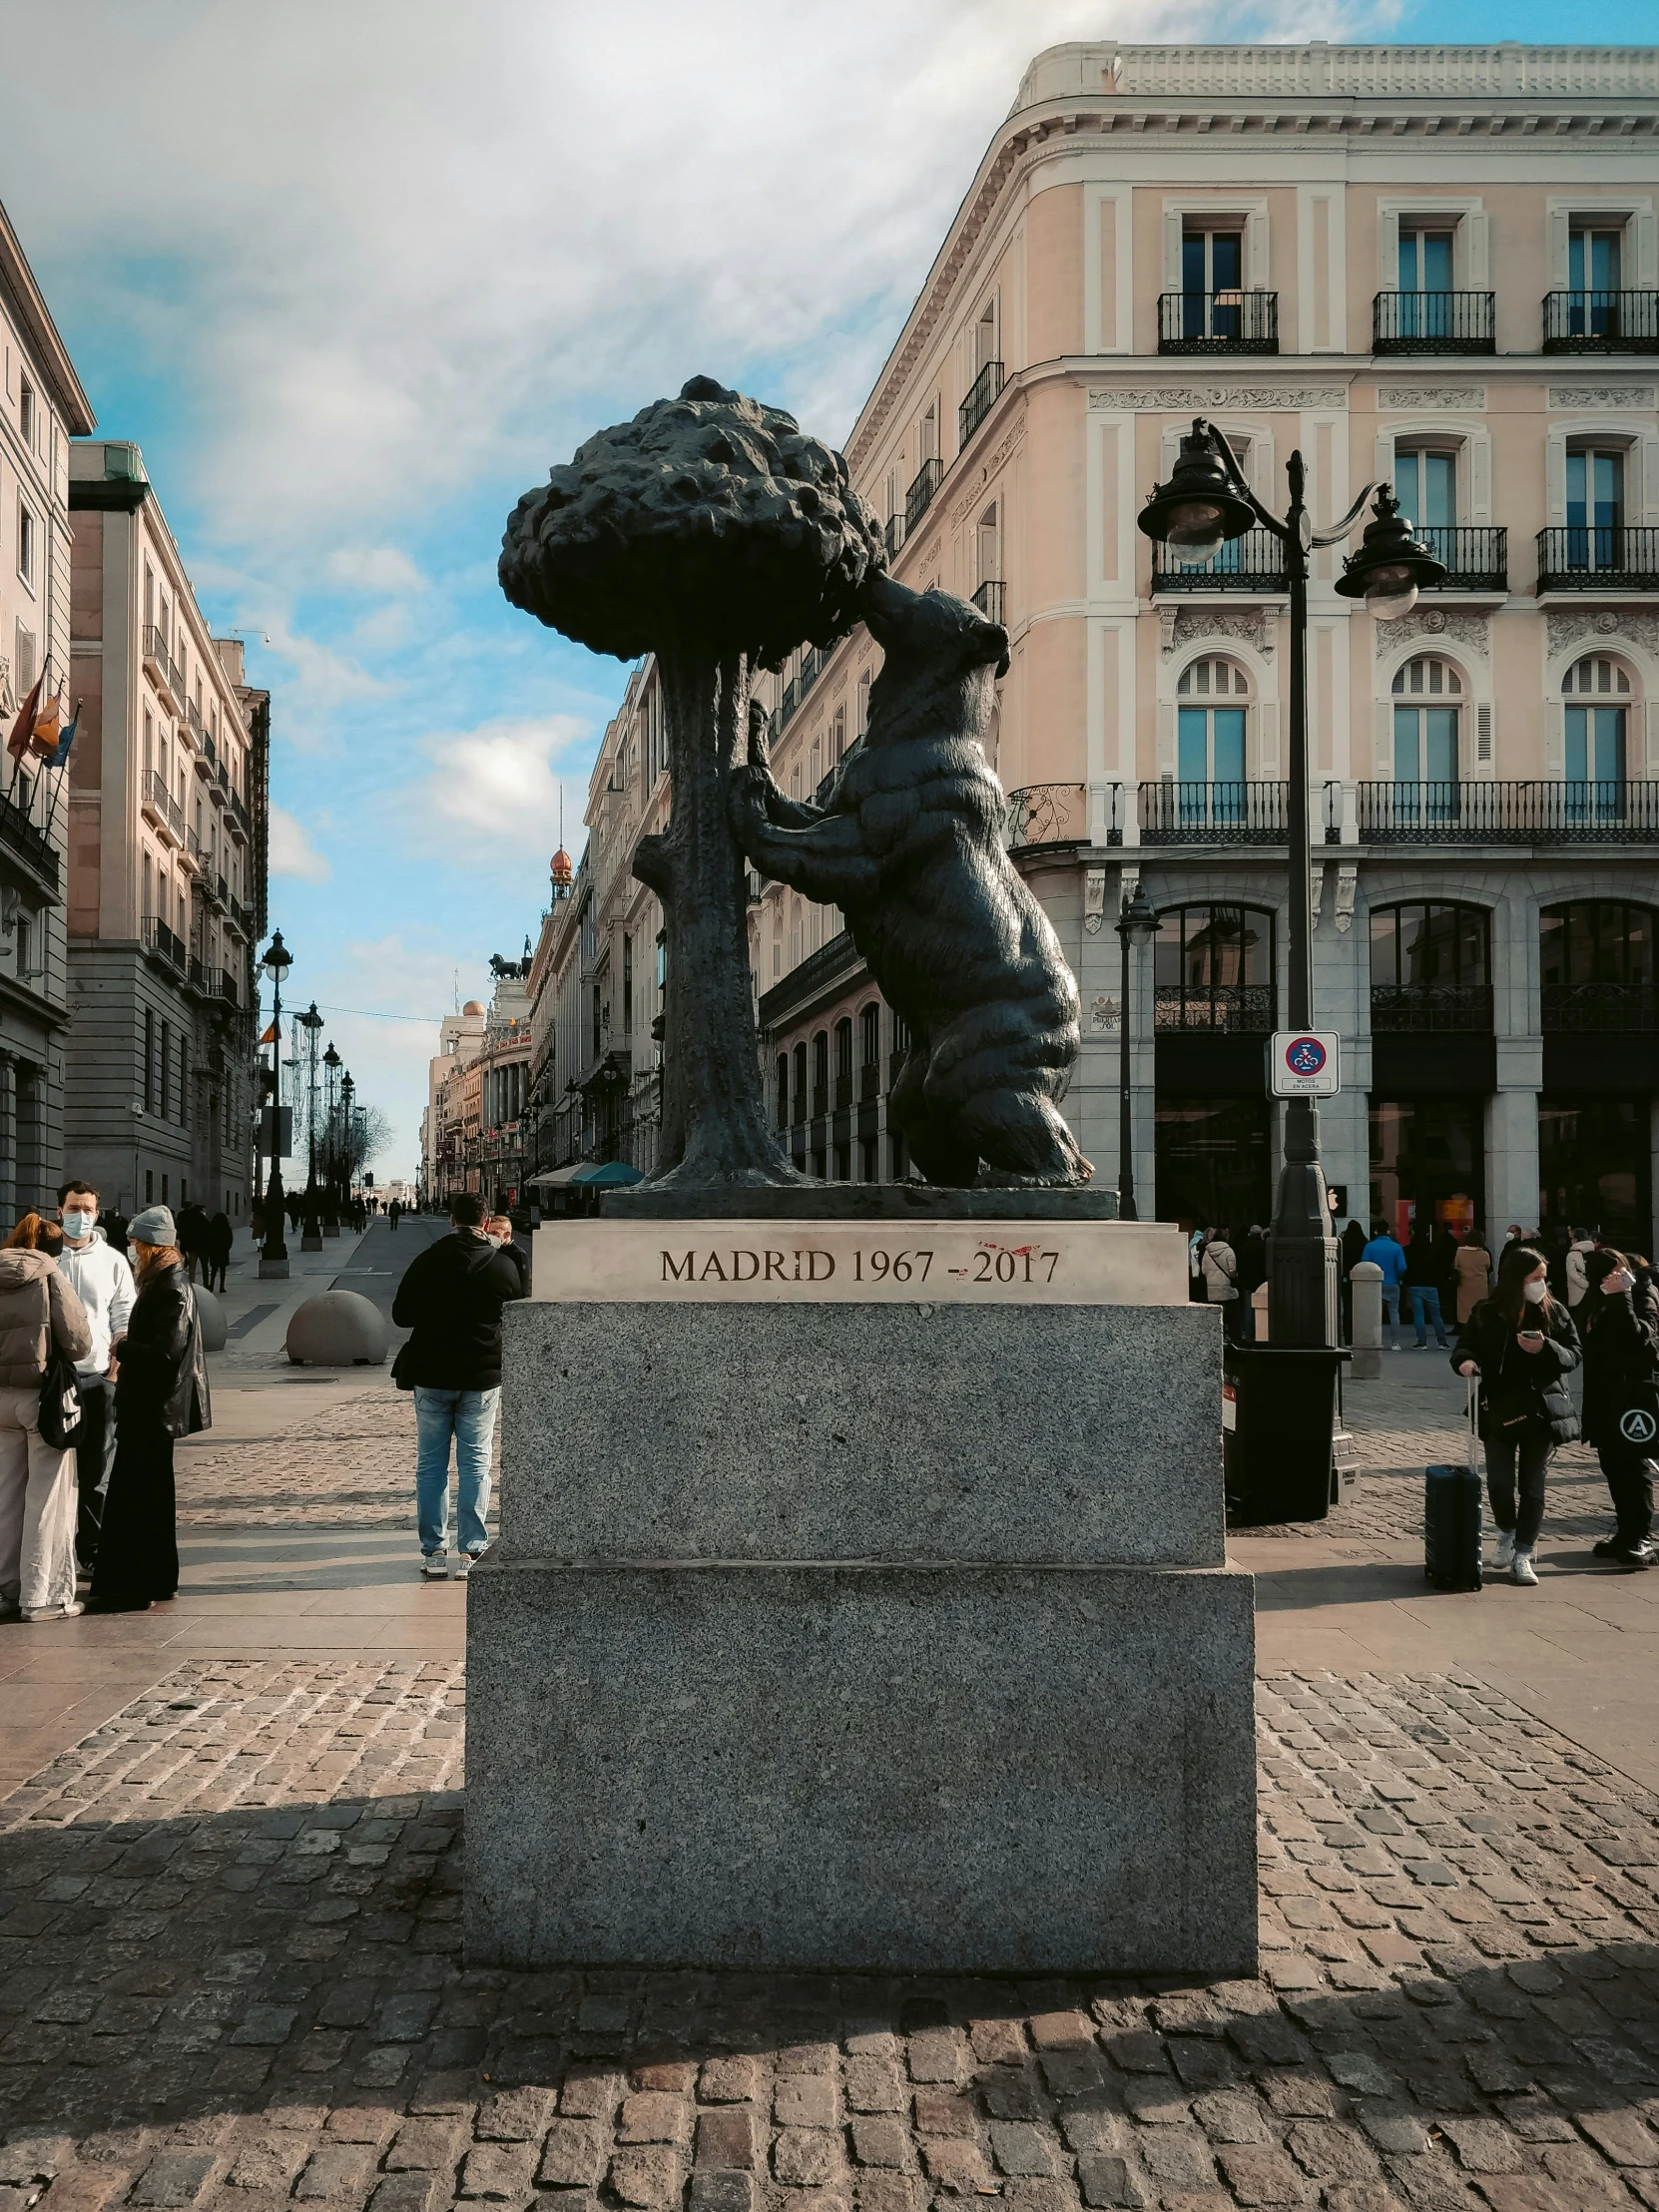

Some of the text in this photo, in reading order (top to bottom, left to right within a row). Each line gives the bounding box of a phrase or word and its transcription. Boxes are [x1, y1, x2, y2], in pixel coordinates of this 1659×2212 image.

[659, 1250, 835, 1282] MADRID
[851, 1250, 934, 1283] 1967
[972, 1250, 1059, 1284] 2017
